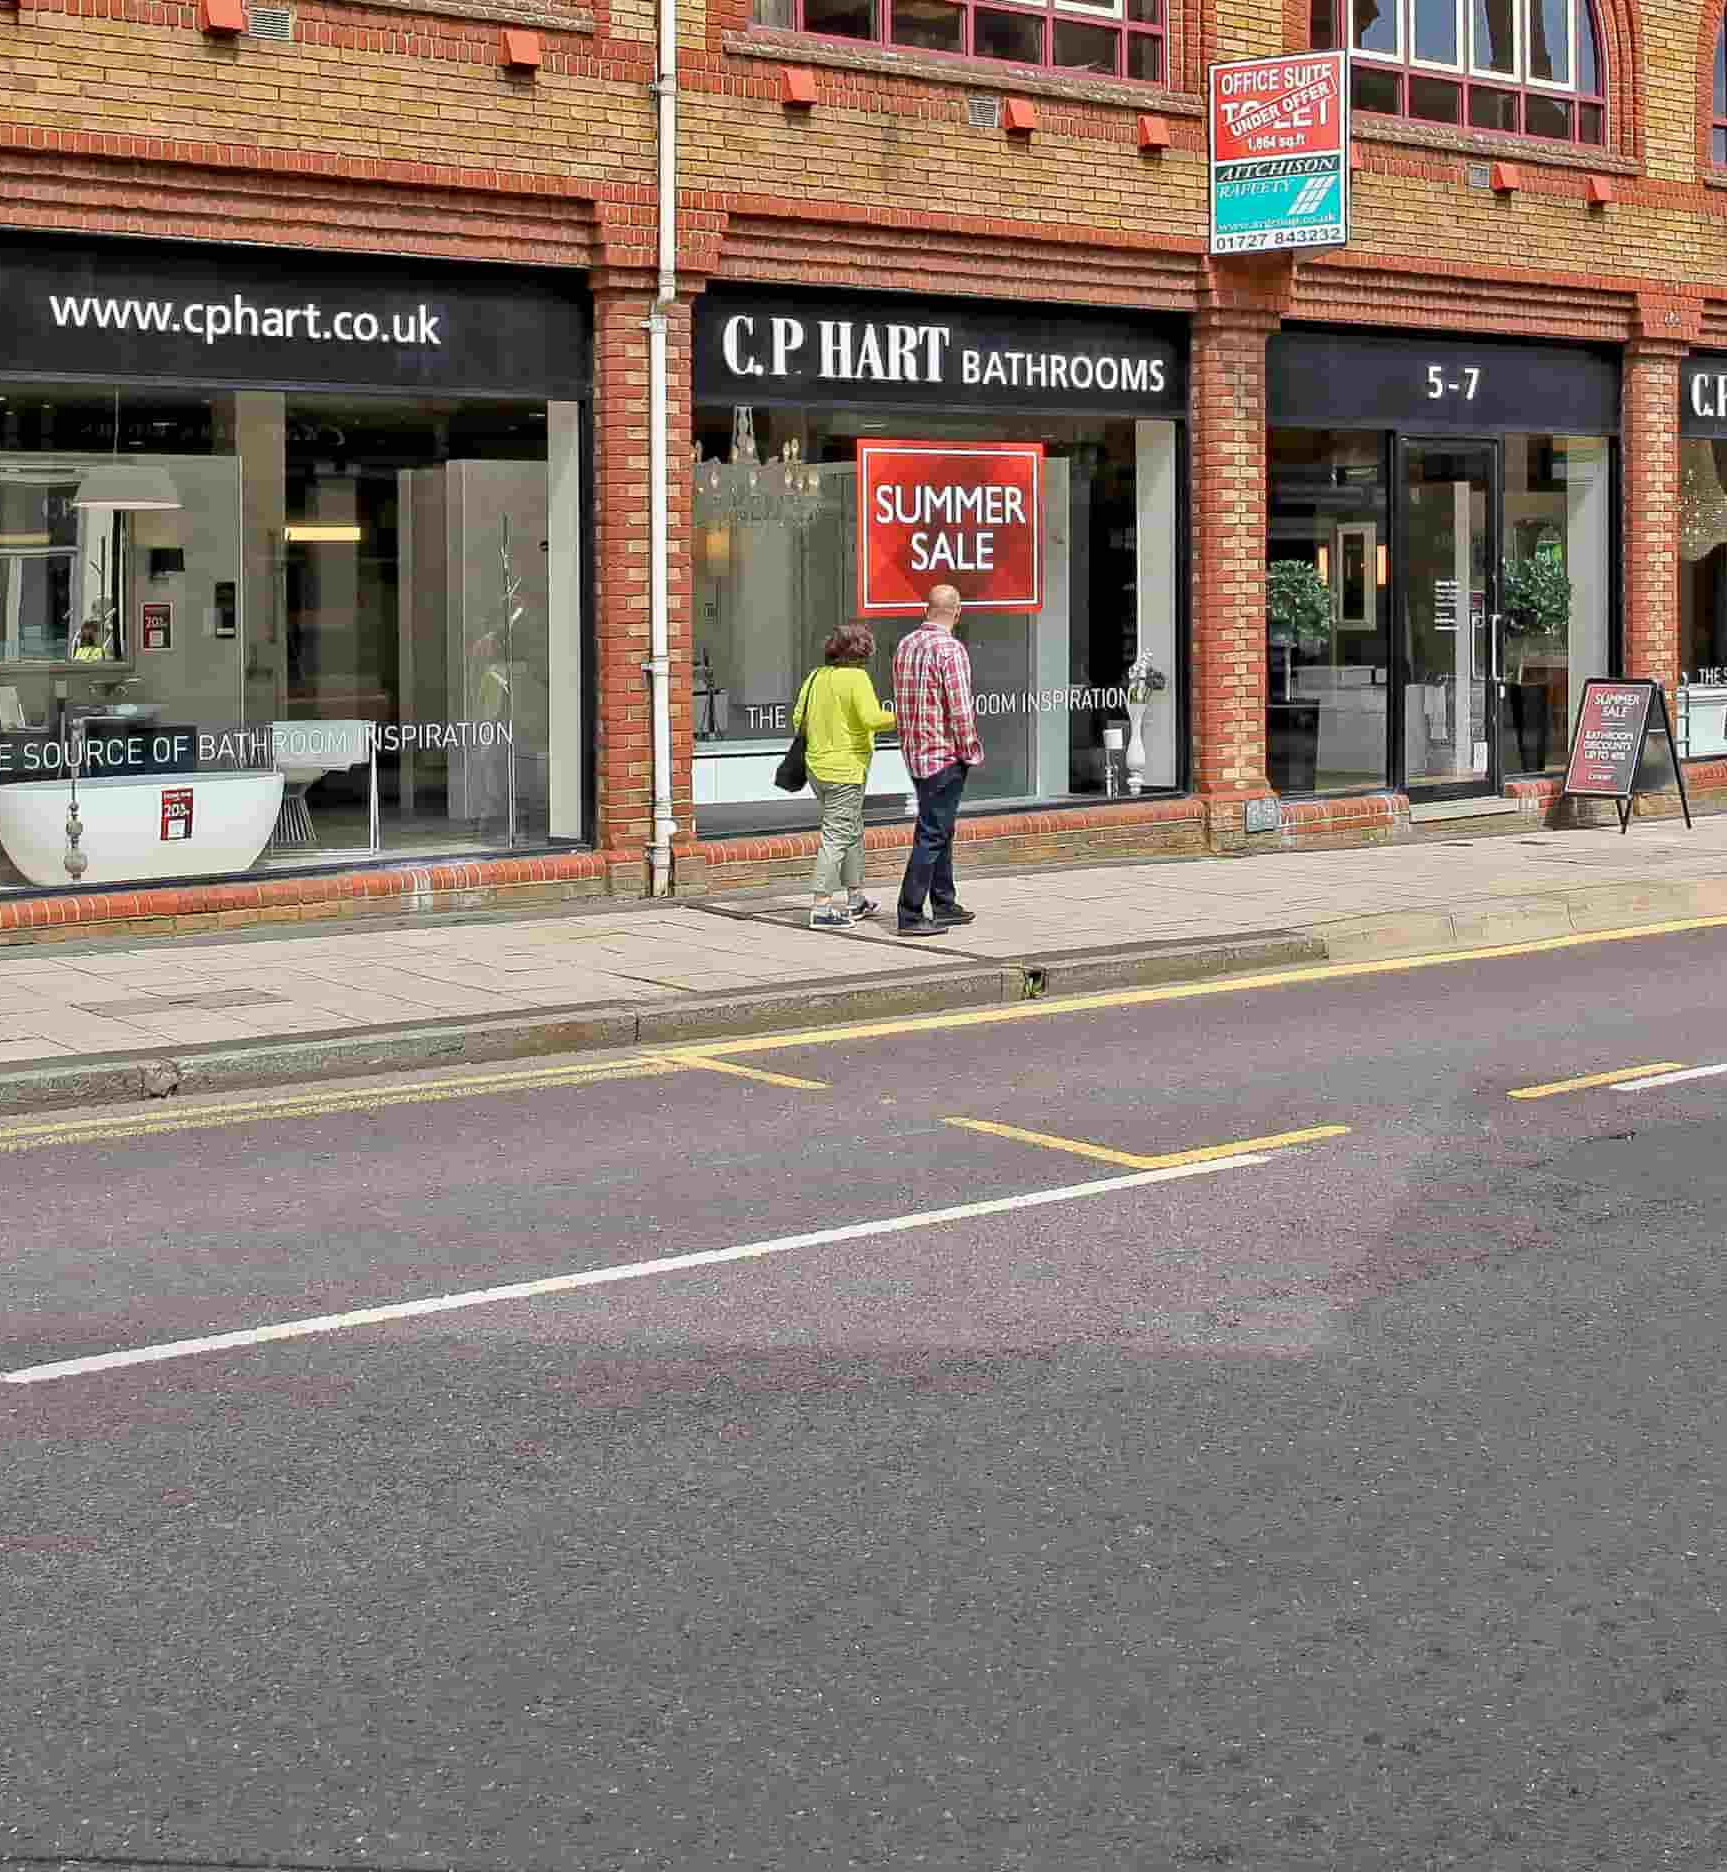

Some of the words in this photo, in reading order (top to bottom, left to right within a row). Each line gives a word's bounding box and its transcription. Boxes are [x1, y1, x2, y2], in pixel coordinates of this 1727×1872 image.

[1222, 69, 1279, 96] OFFICE
[1283, 63, 1333, 89] SUITE
[1230, 106, 1281, 137] UNDER
[1282, 82, 1330, 112] OFFER
[1219, 156, 1337, 181] AITCHISON
[1216, 232, 1267, 251] 01727
[1274, 227, 1342, 245] 843232
[49, 293, 442, 345] www.cphart.co.uk
[817, 320, 950, 383] HART
[961, 349, 1166, 393] BATHROOMS
[1427, 365, 1480, 401] 5-7
[875, 483, 1026, 525] SUMMER
[910, 532, 994, 571] SALE
[1698, 667, 1721, 685] THE
[745, 705, 787, 730] THE
[1021, 687, 1131, 715] INSPIRATION
[1593, 693, 1640, 705] SUMMER
[1602, 705, 1632, 718] SALE
[22, 737, 144, 772] SOURCE
[152, 734, 190, 765] OF
[197, 727, 349, 763] BATHROOM
[360, 720, 514, 753] INSPIRATION
